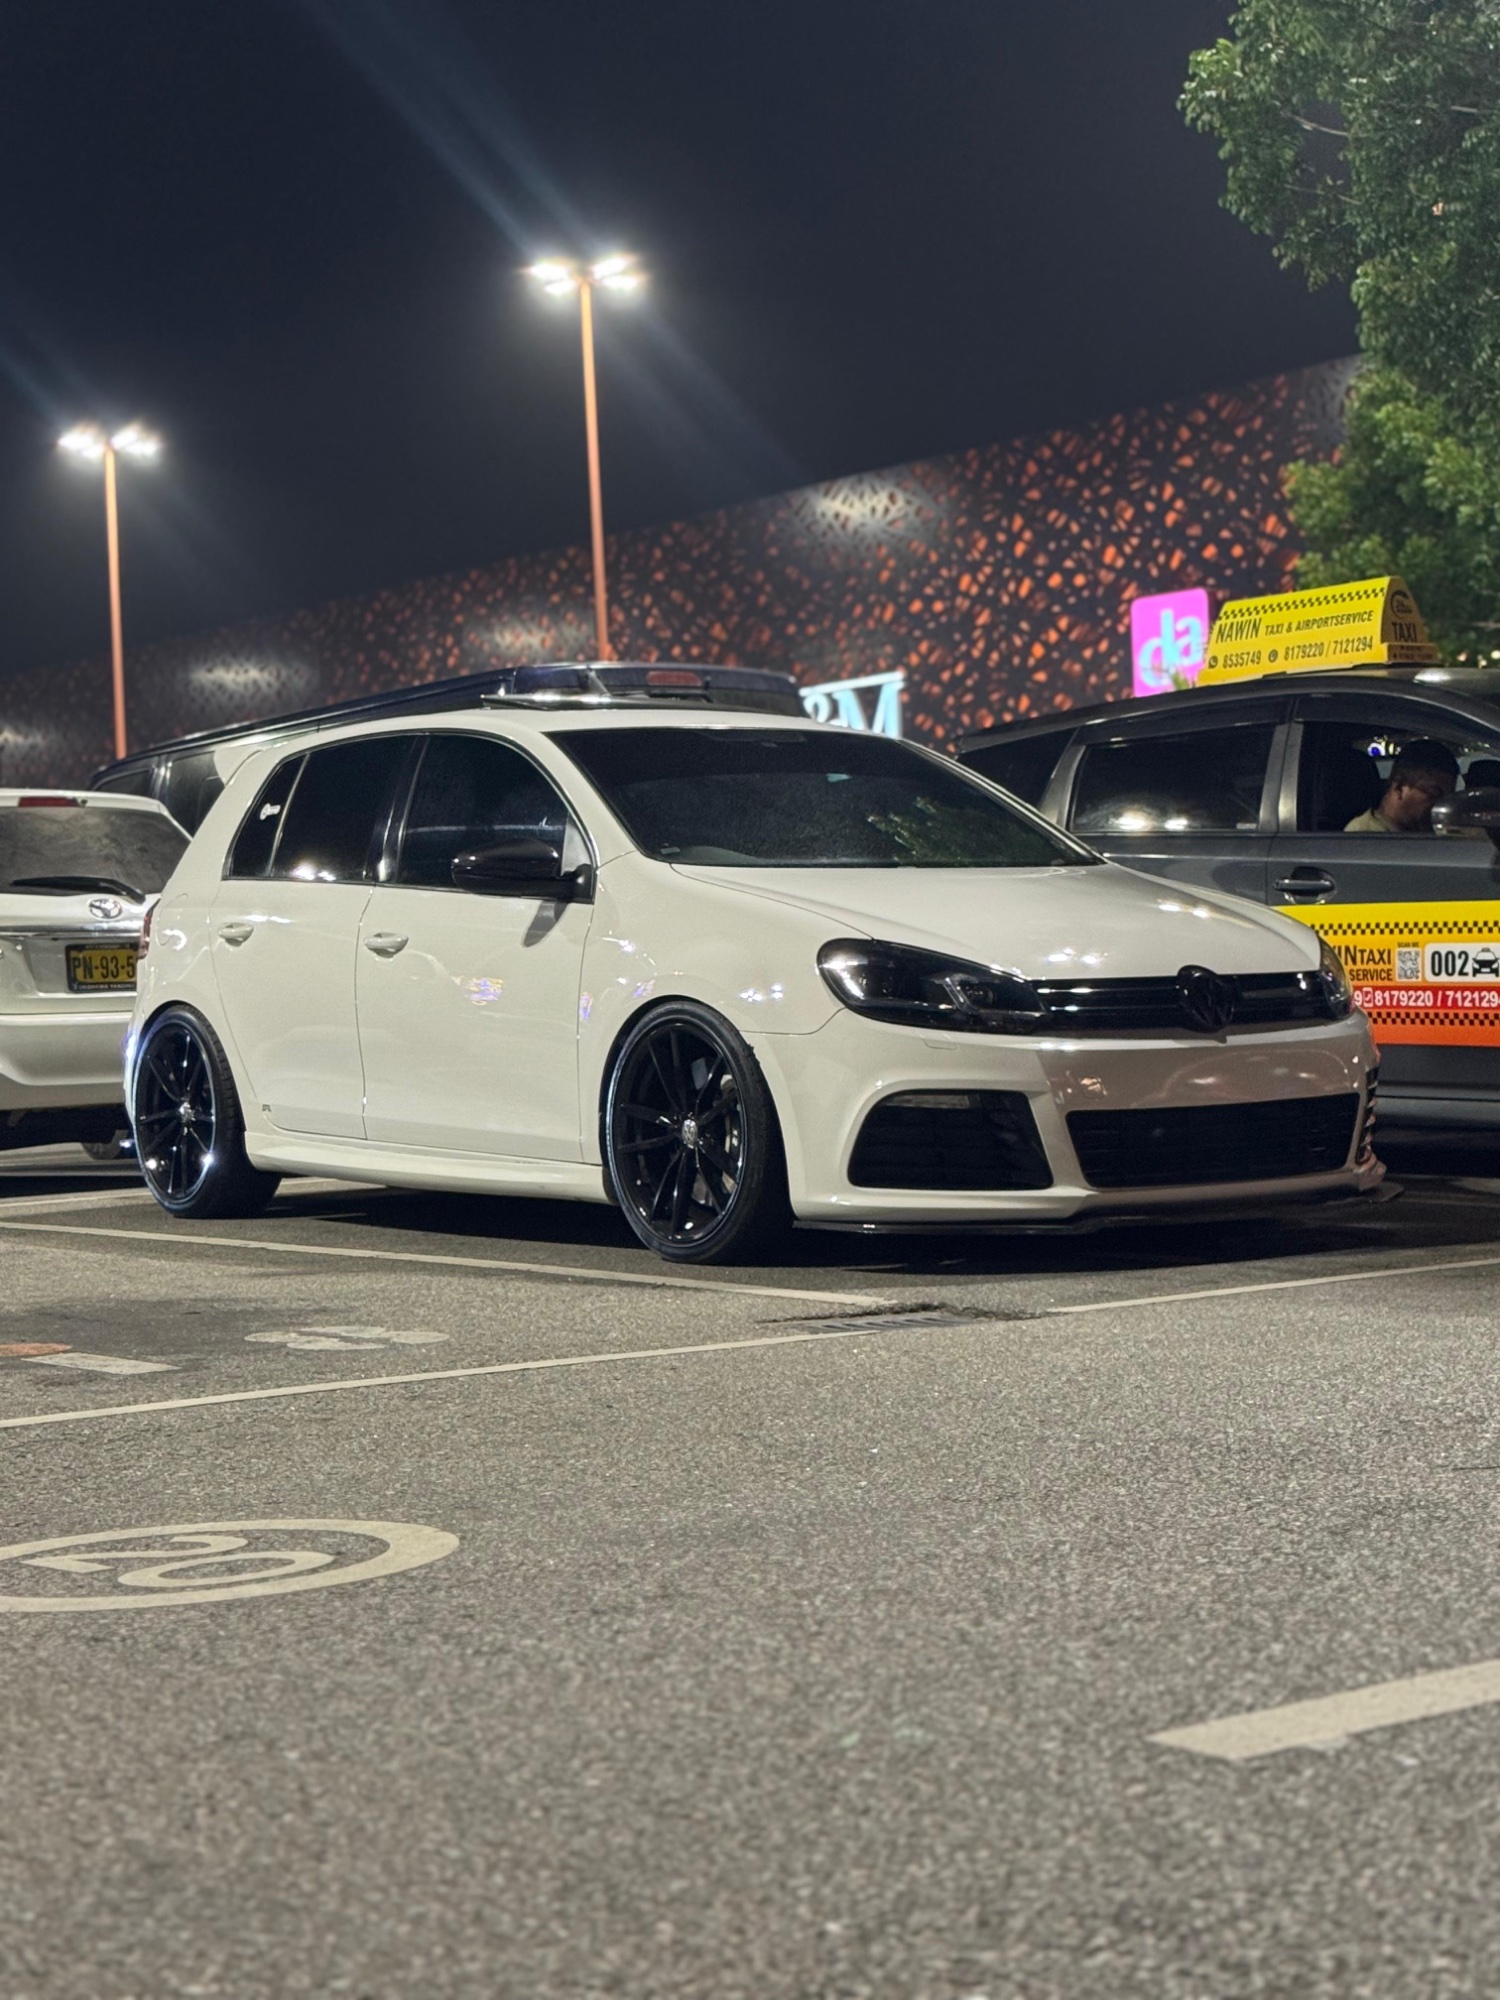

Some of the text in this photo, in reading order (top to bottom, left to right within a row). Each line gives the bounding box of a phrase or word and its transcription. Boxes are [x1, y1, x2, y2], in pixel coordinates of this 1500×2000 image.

[1215, 617, 1262, 644] NAWIN
[1265, 624, 1284, 637] TAXI
[1286, 622, 1293, 633] &
[1391, 621, 1418, 643] TAXI
[1139, 608, 1203, 688] da
[1222, 650, 1262, 669] 8535749
[1284, 642, 1324, 661] 8179220
[1333, 636, 1374, 655] 7121294
[1349, 968, 1393, 982] SERVICE
[1431, 950, 1469, 977] 002
[1374, 990, 1434, 1007] 8179220
[1445, 990, 1500, 1008] 712129
